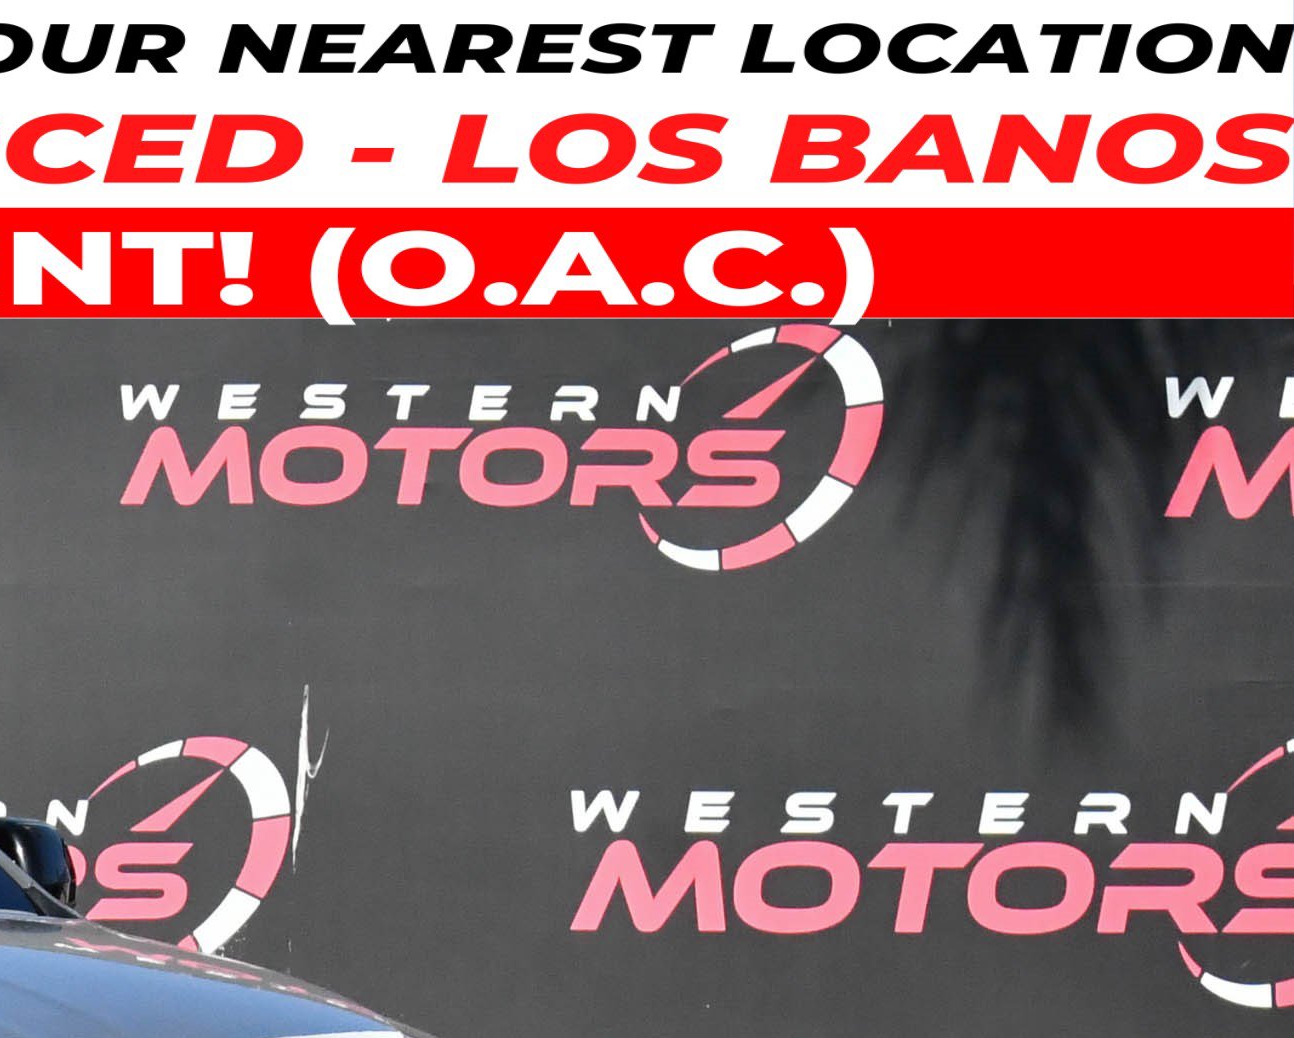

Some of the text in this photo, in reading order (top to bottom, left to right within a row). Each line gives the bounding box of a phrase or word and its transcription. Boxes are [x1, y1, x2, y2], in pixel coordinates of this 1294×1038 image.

[120, 383, 681, 422] WESTERN
[121, 425, 787, 509] MOTORS
[570, 790, 1228, 835] WESTERN
